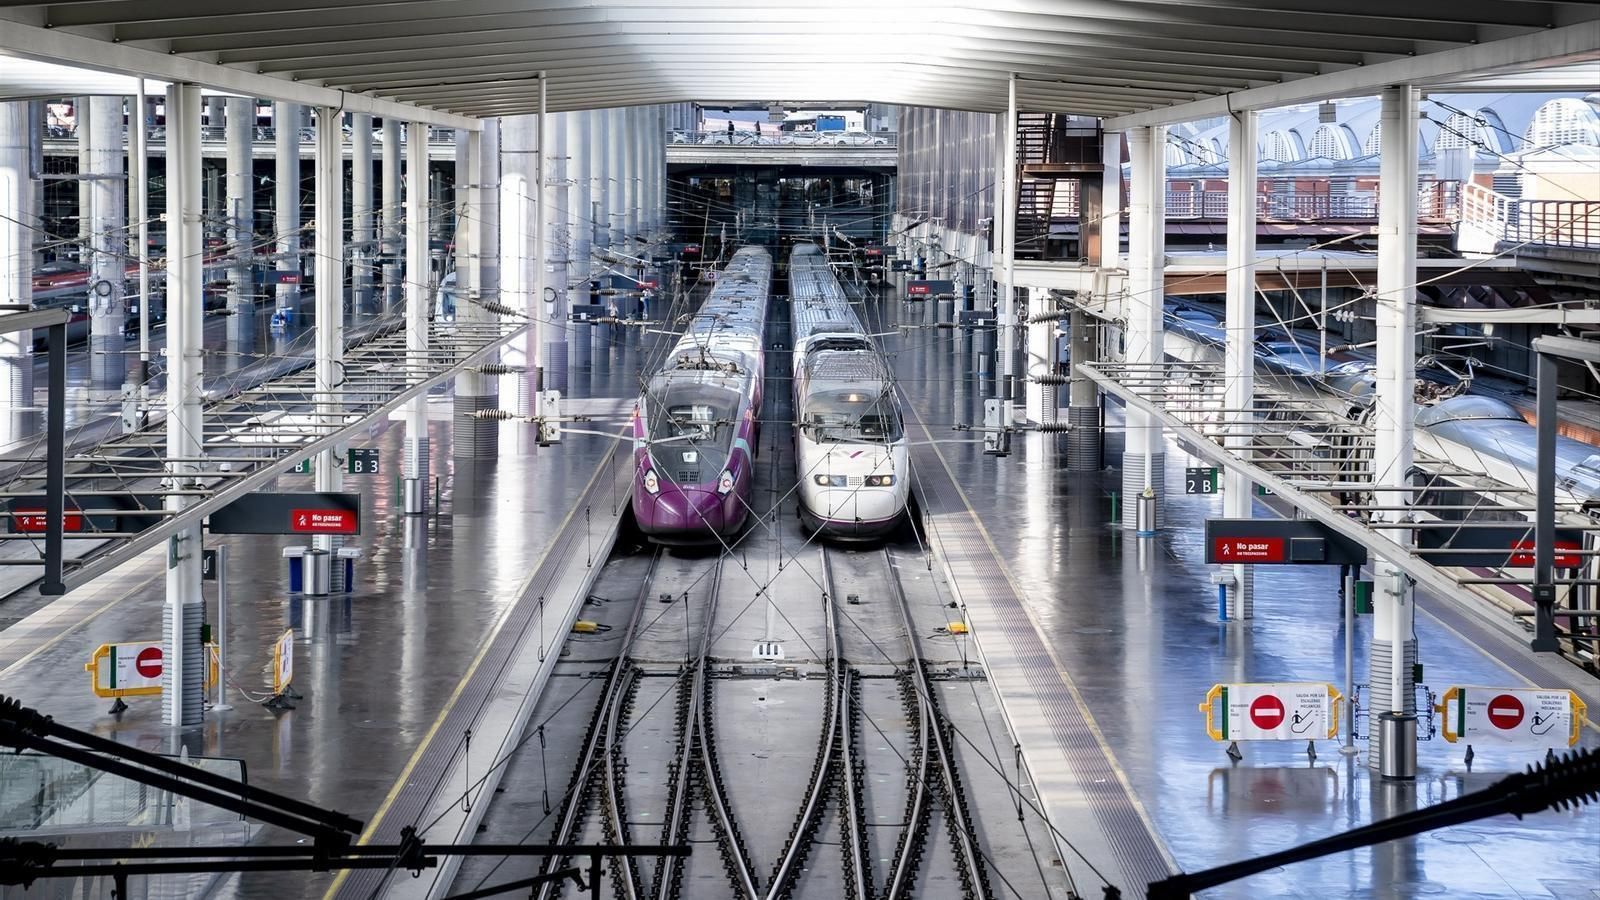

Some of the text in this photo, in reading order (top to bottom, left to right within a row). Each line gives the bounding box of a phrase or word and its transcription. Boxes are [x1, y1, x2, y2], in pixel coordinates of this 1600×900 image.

[355, 460, 378, 472] B 3
[1188, 480, 1211, 493] 2 B
[1237, 542, 1269, 551] No pasar
